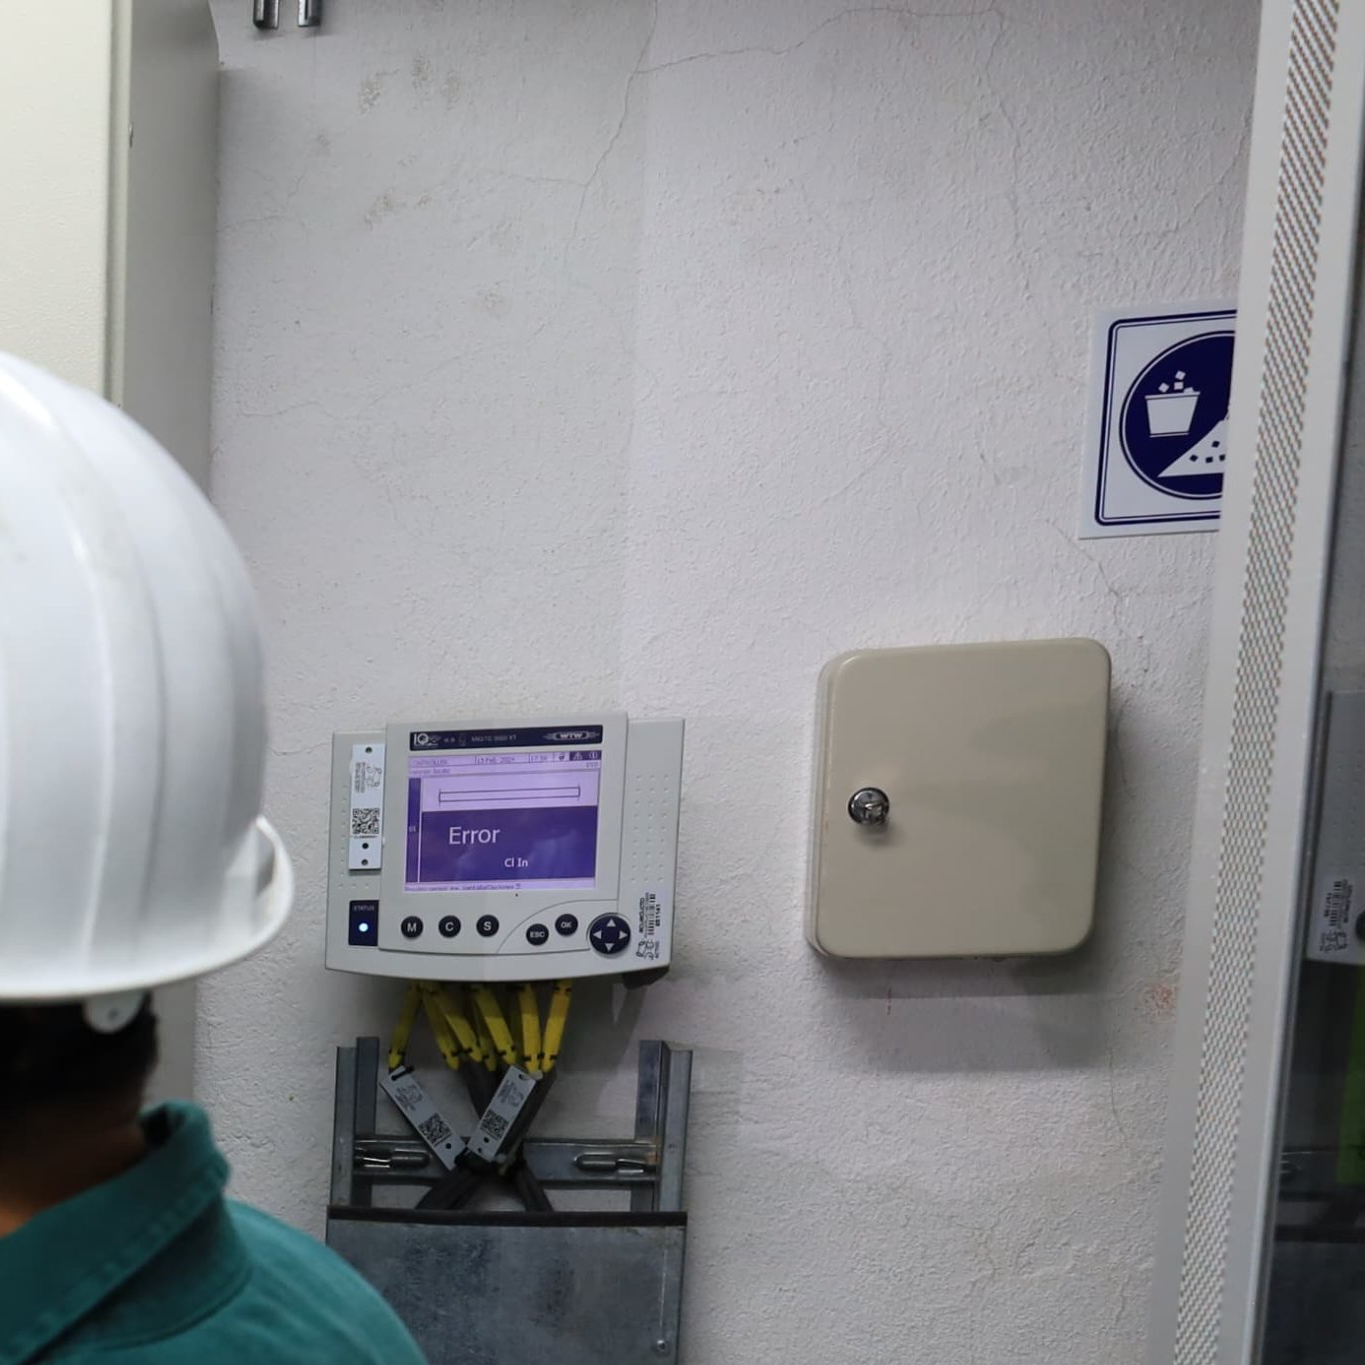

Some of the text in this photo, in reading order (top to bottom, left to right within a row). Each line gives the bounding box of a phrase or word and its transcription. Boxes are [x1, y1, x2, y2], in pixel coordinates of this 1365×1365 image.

[448, 827, 500, 844] Error
[406, 922, 417, 932] M
[445, 921, 454, 931] C
[483, 921, 492, 931] S
